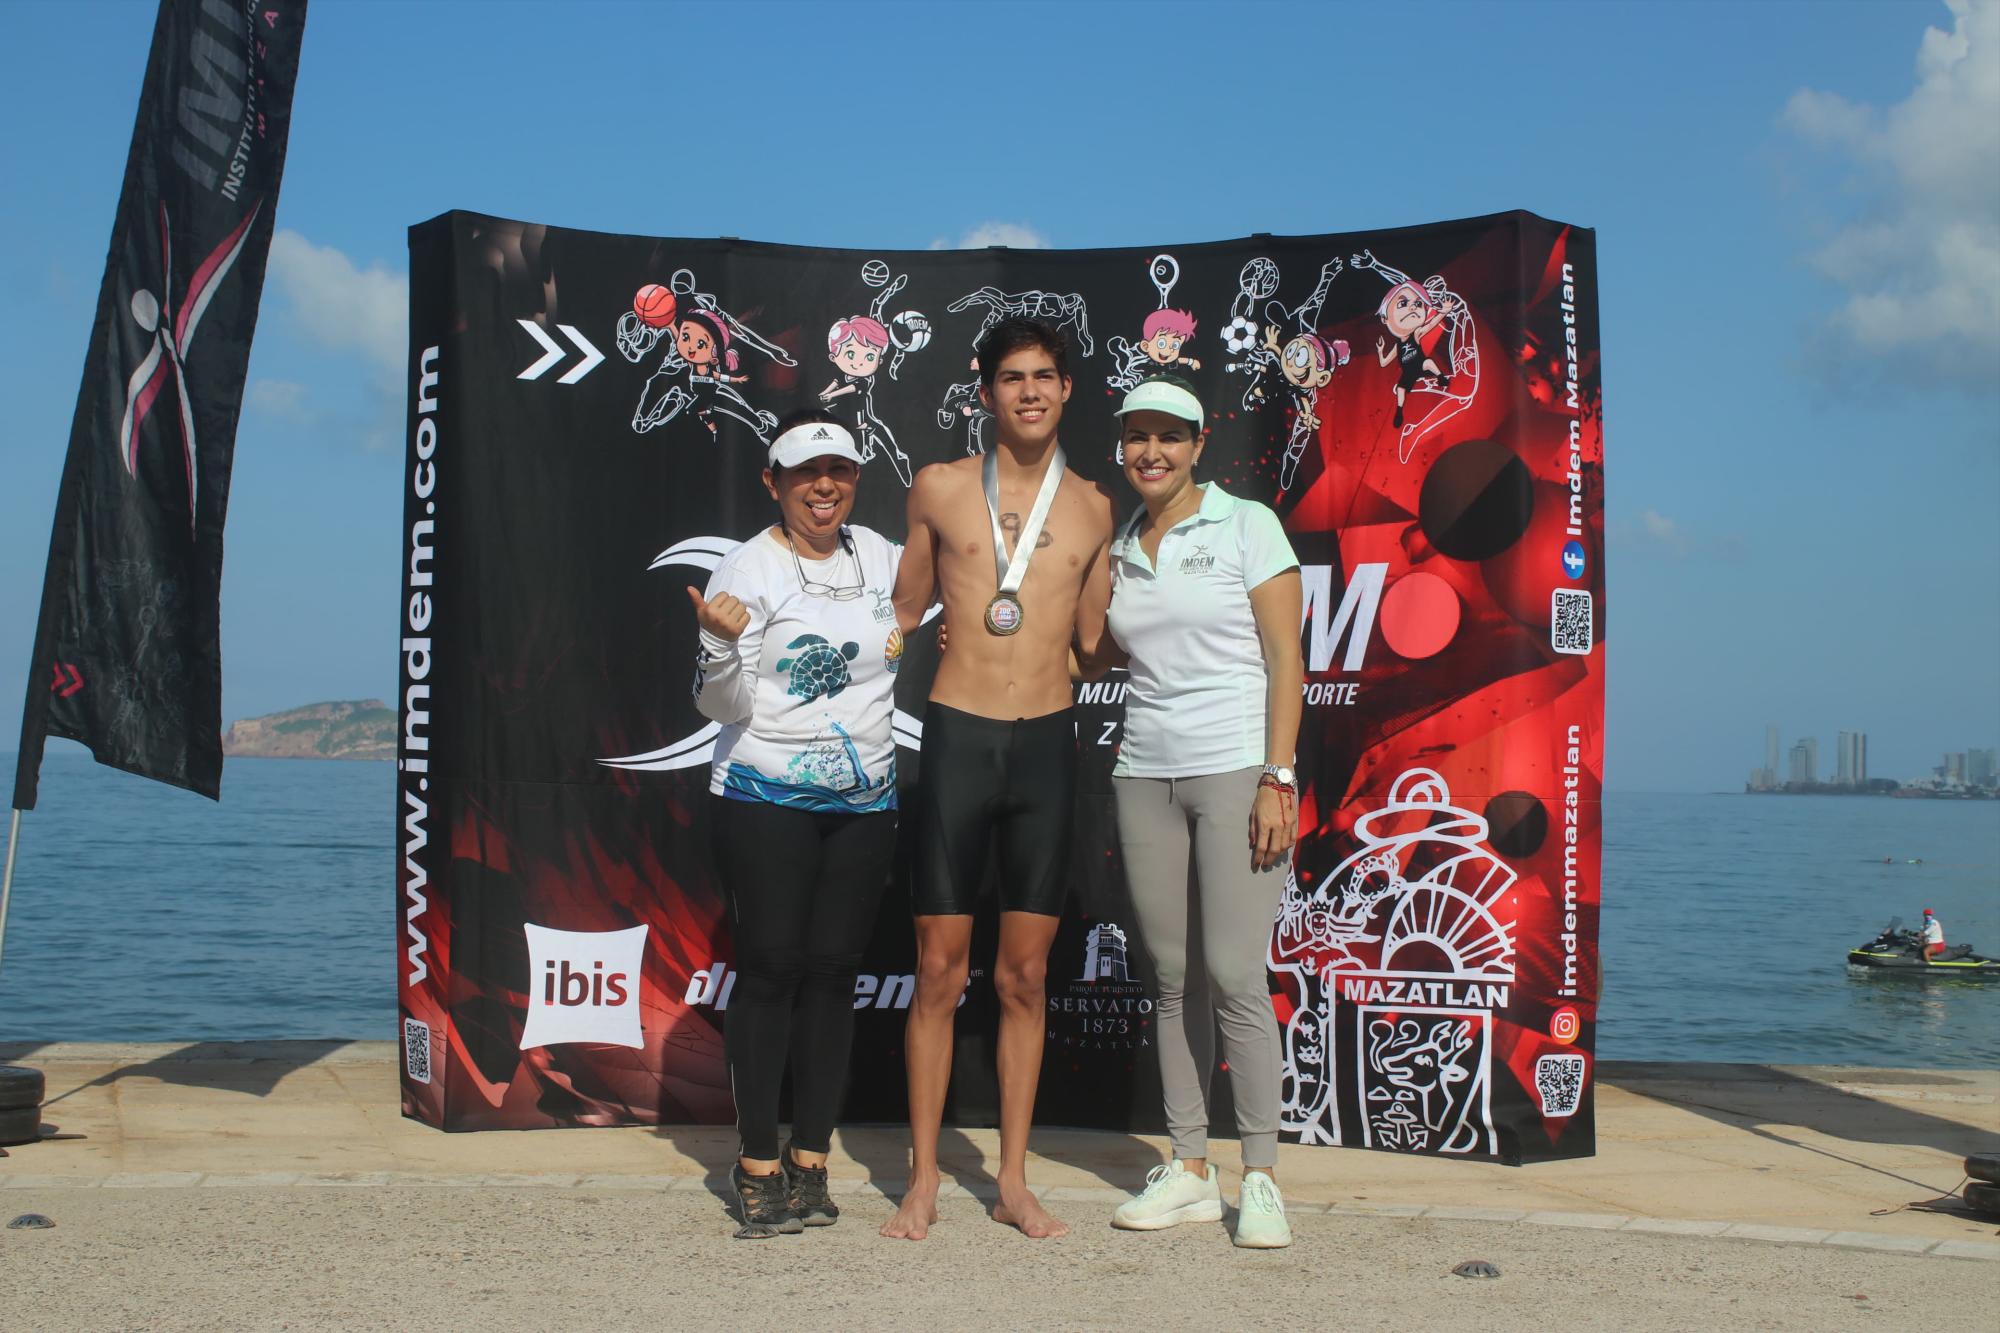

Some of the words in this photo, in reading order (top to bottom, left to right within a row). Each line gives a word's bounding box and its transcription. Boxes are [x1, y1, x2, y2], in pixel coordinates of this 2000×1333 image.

[1561, 262, 1579, 409] Mazatlan
[1567, 419, 1582, 536] Imdem
[1180, 556, 1215, 569] IMDEM
[399, 345, 439, 987] www.imdem.com
[1558, 725, 1581, 997] imdemmazatlan
[544, 959, 628, 1007] ibis
[1343, 979, 1509, 1008] MAZATLAN
[1082, 1018, 1129, 1034] 1873
